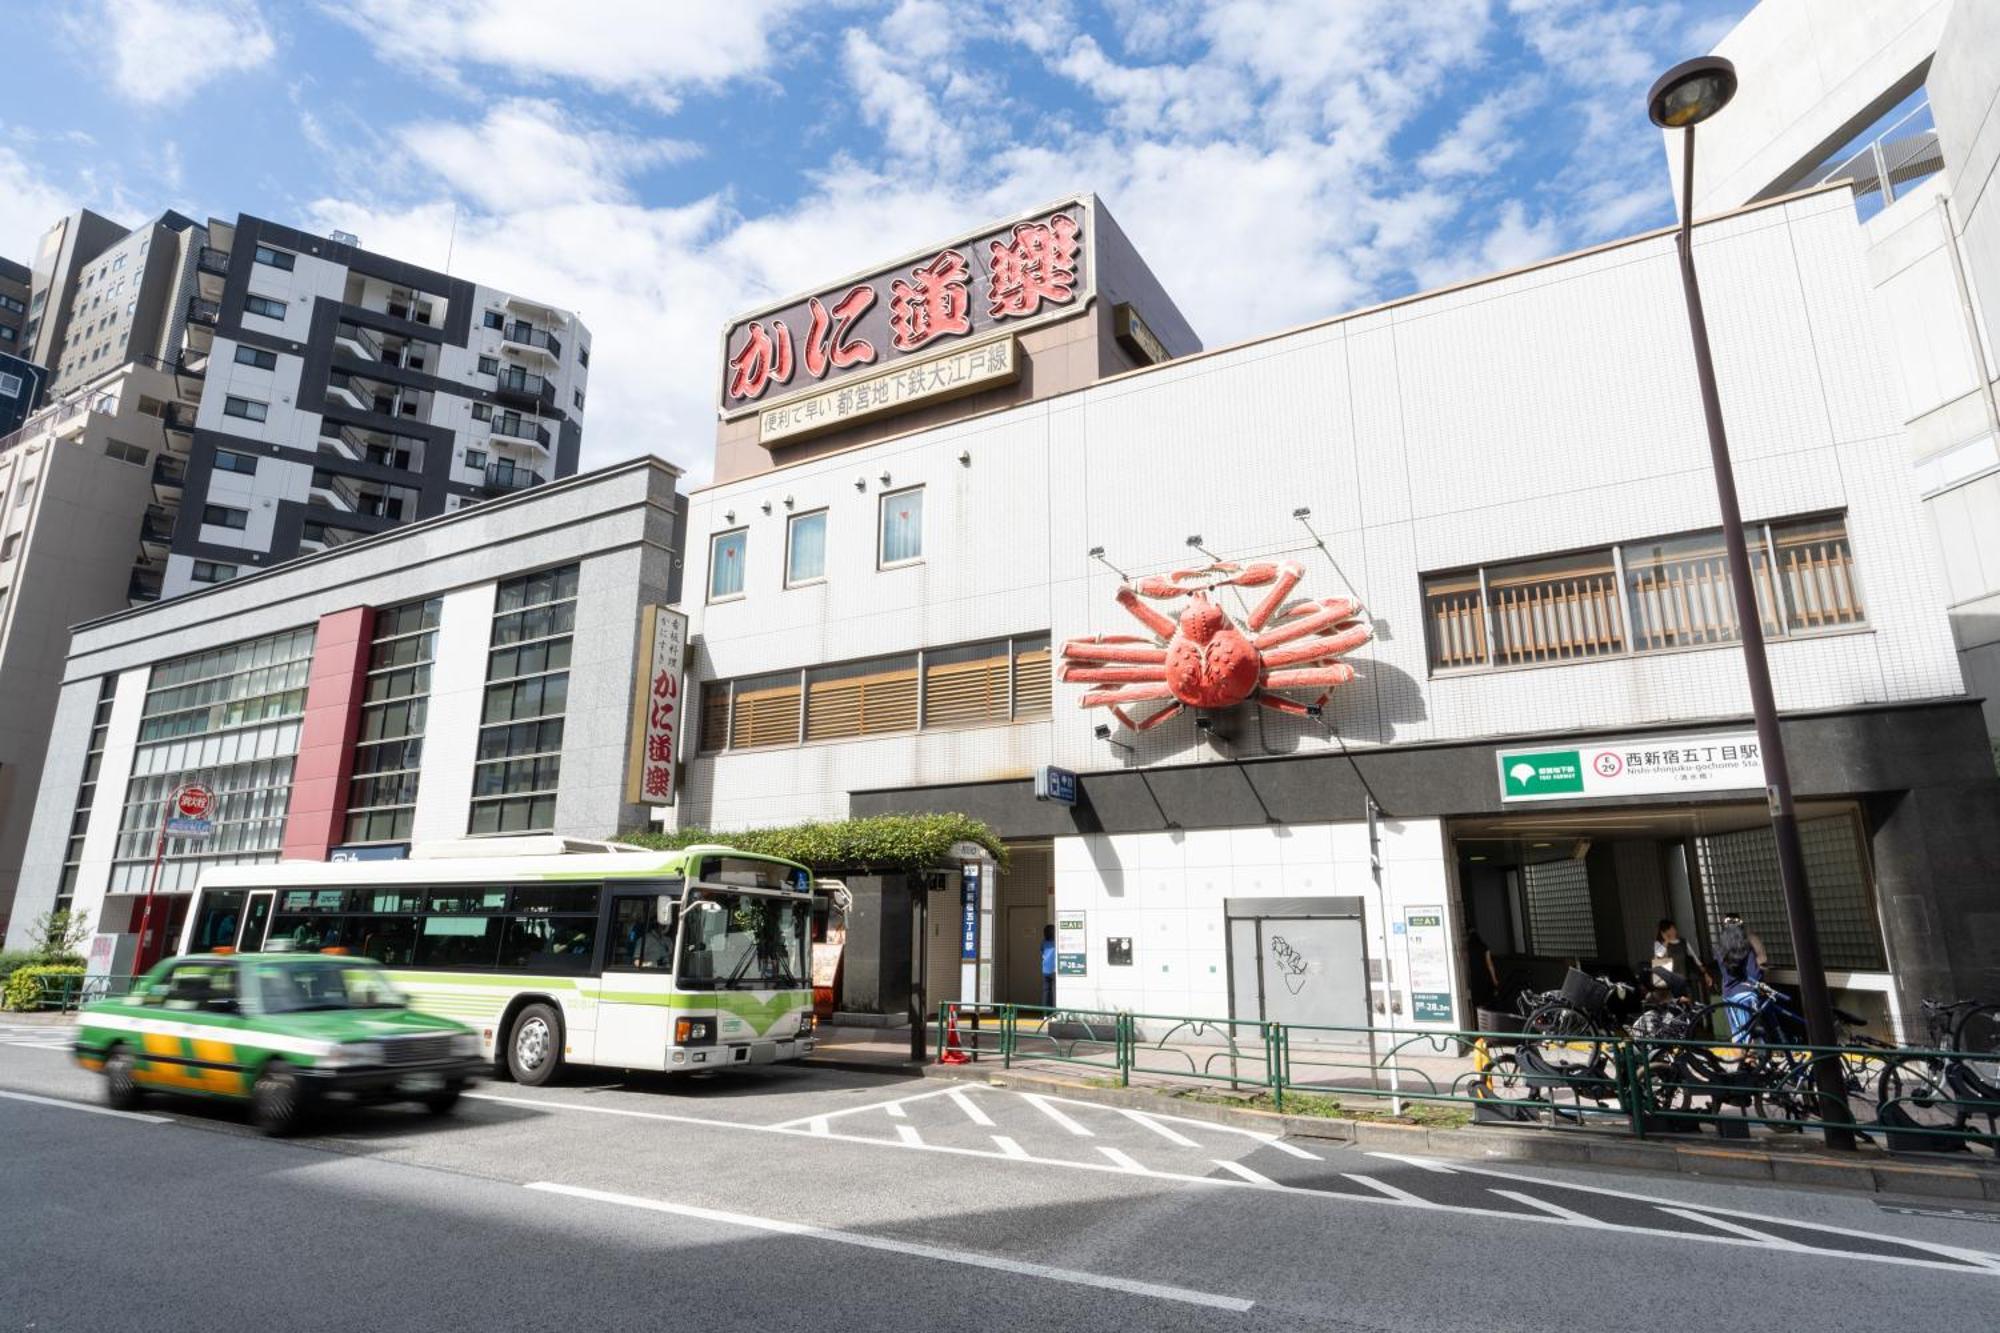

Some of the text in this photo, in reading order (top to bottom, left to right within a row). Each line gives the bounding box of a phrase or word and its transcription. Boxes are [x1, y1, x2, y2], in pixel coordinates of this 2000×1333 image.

[764, 344, 1008, 434] 便利で早い 都営地下鉄大江戸線
[1626, 744, 1759, 767] 西新宿五丁目駅
[1601, 763, 1616, 773] 29
